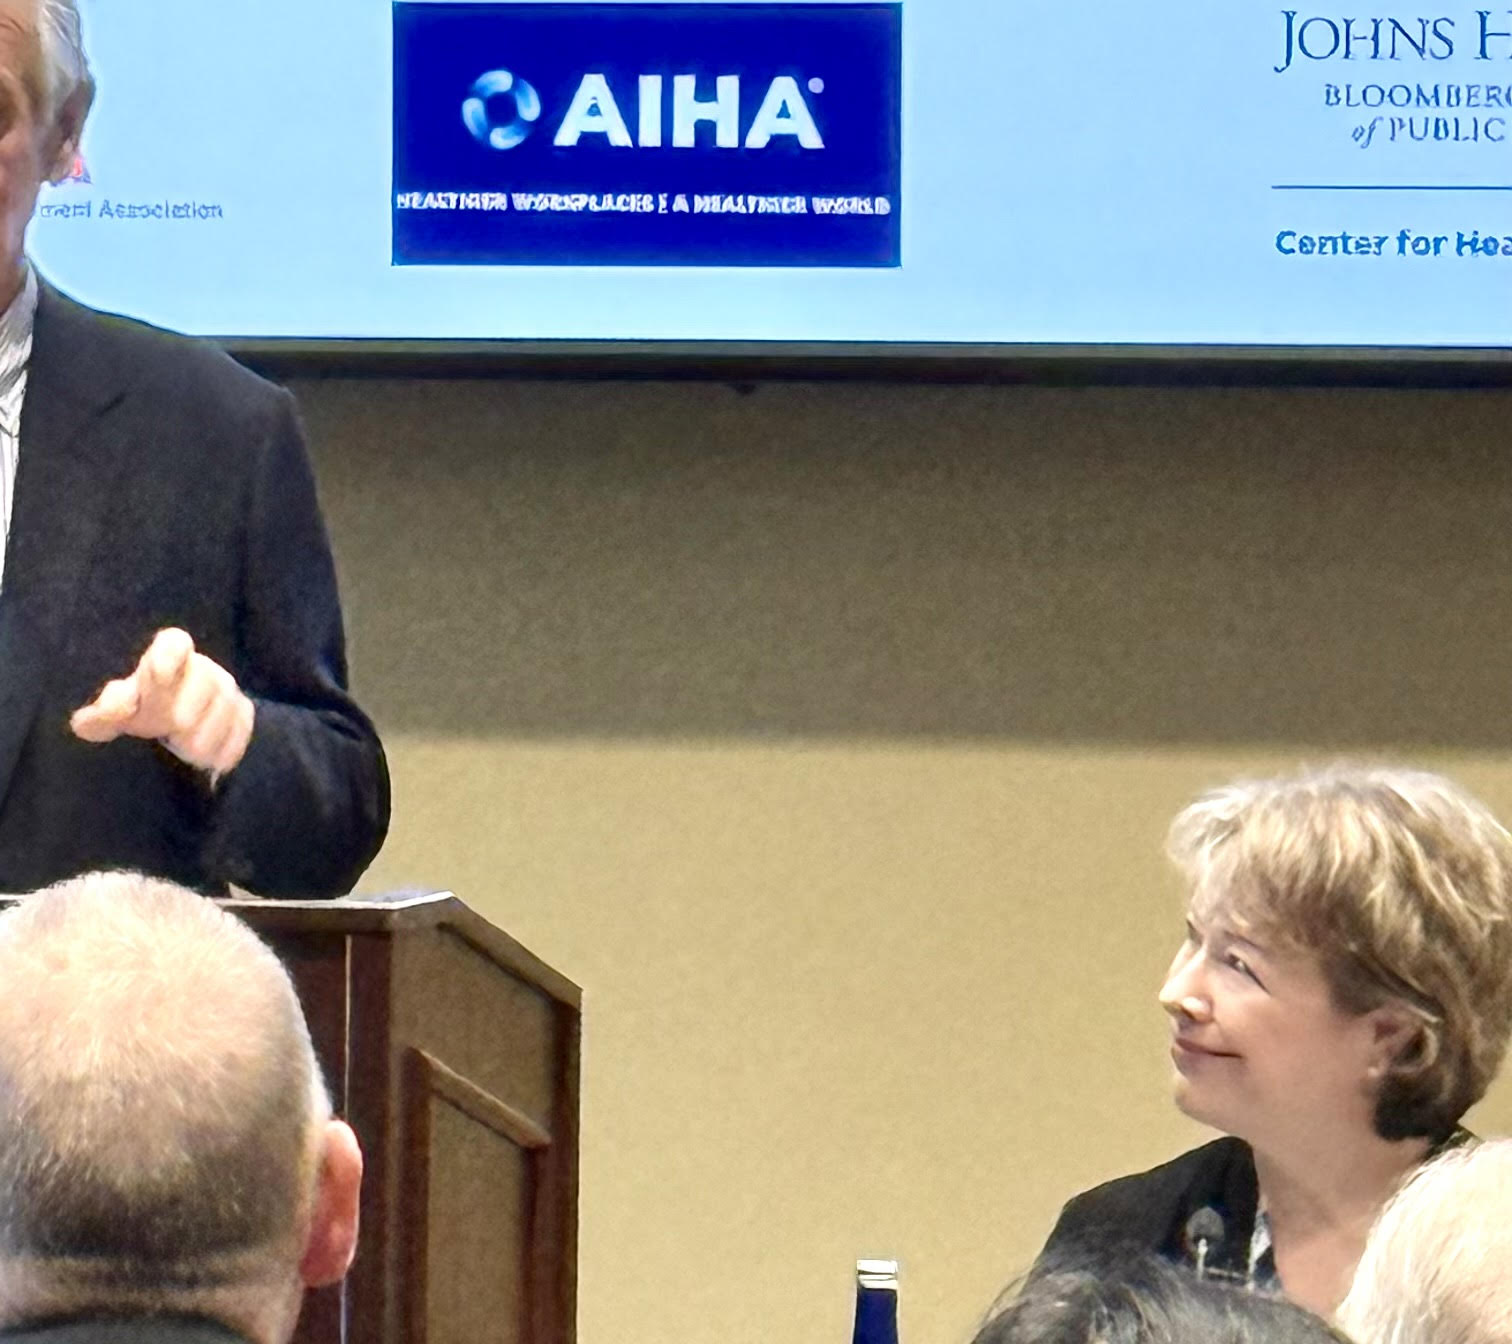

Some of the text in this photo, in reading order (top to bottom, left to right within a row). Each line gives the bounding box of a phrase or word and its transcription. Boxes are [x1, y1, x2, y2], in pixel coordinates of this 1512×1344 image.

[1273, 9, 1456, 74] JOHNS
[553, 72, 826, 150] AIHA
[1351, 115, 1506, 150] of PUBLIC
[1275, 229, 1387, 258] Center
[1395, 228, 1449, 258] for
